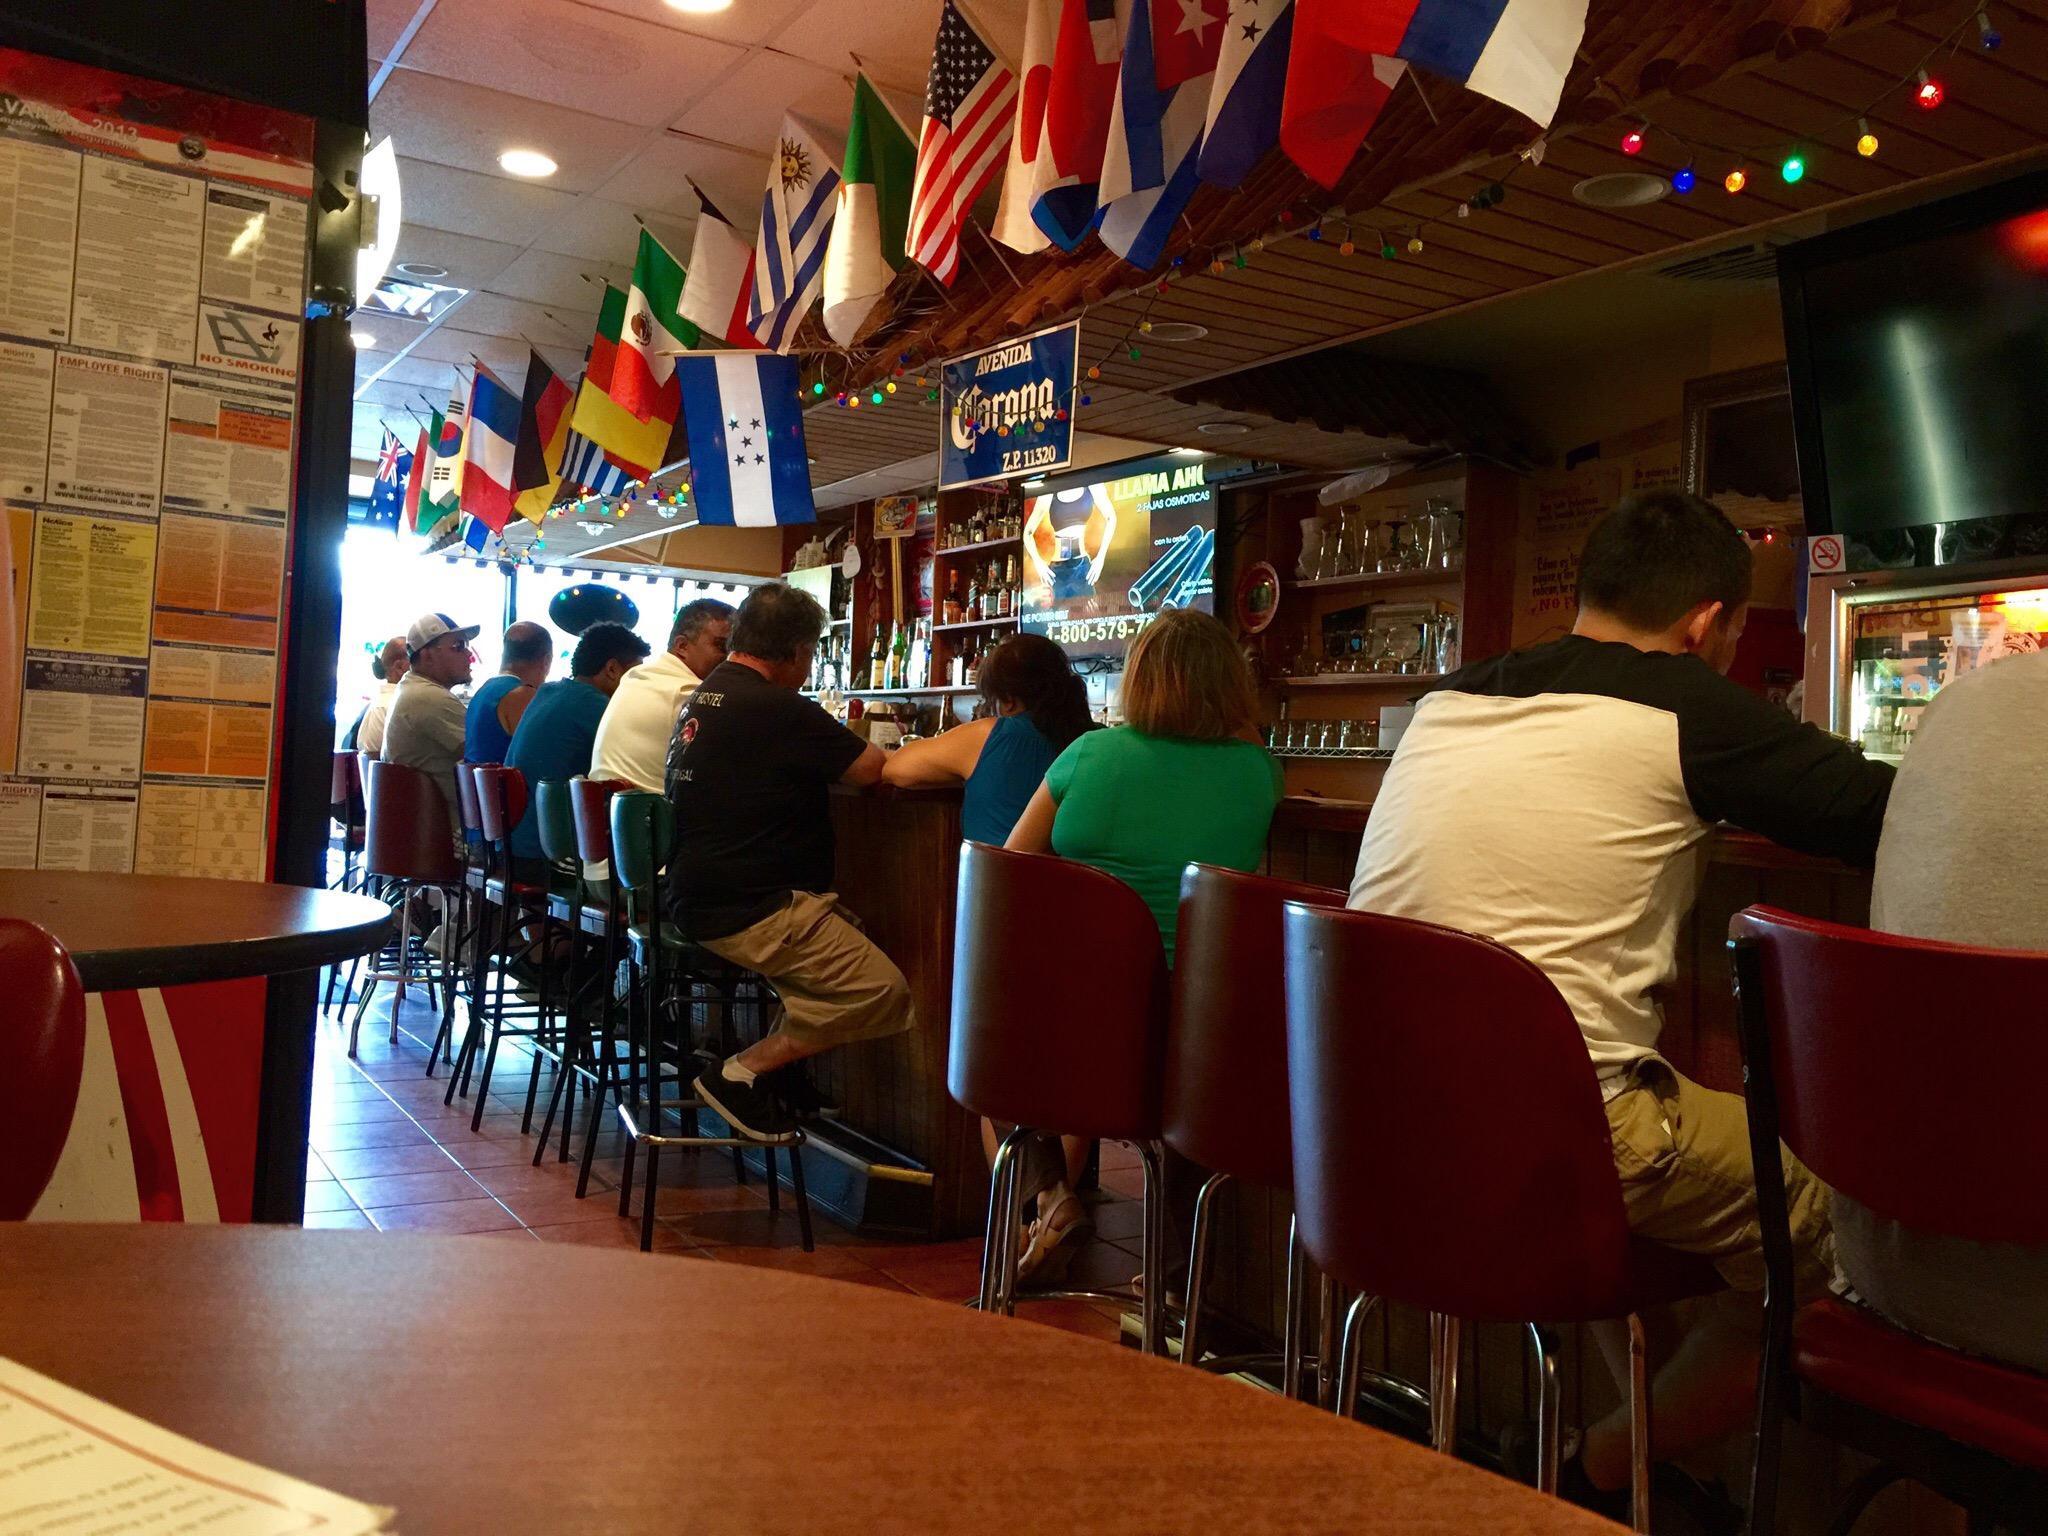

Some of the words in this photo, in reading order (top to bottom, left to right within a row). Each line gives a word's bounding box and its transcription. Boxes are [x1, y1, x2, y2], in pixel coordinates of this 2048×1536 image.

[91, 118, 139, 140] 2013
[59, 356, 121, 374] EMPLOYEE
[123, 366, 165, 381] RIGHTS
[199, 353, 223, 365] NO
[226, 356, 296, 378] SMOKING
[974, 341, 1033, 377] AVENIDA
[950, 376, 1055, 455] Corona
[1023, 445, 1056, 469] 11320
[1113, 471, 1170, 501] LLAMA
[1164, 490, 1210, 508] OSMOTICAS
[696, 691, 725, 708] HOSTEL
